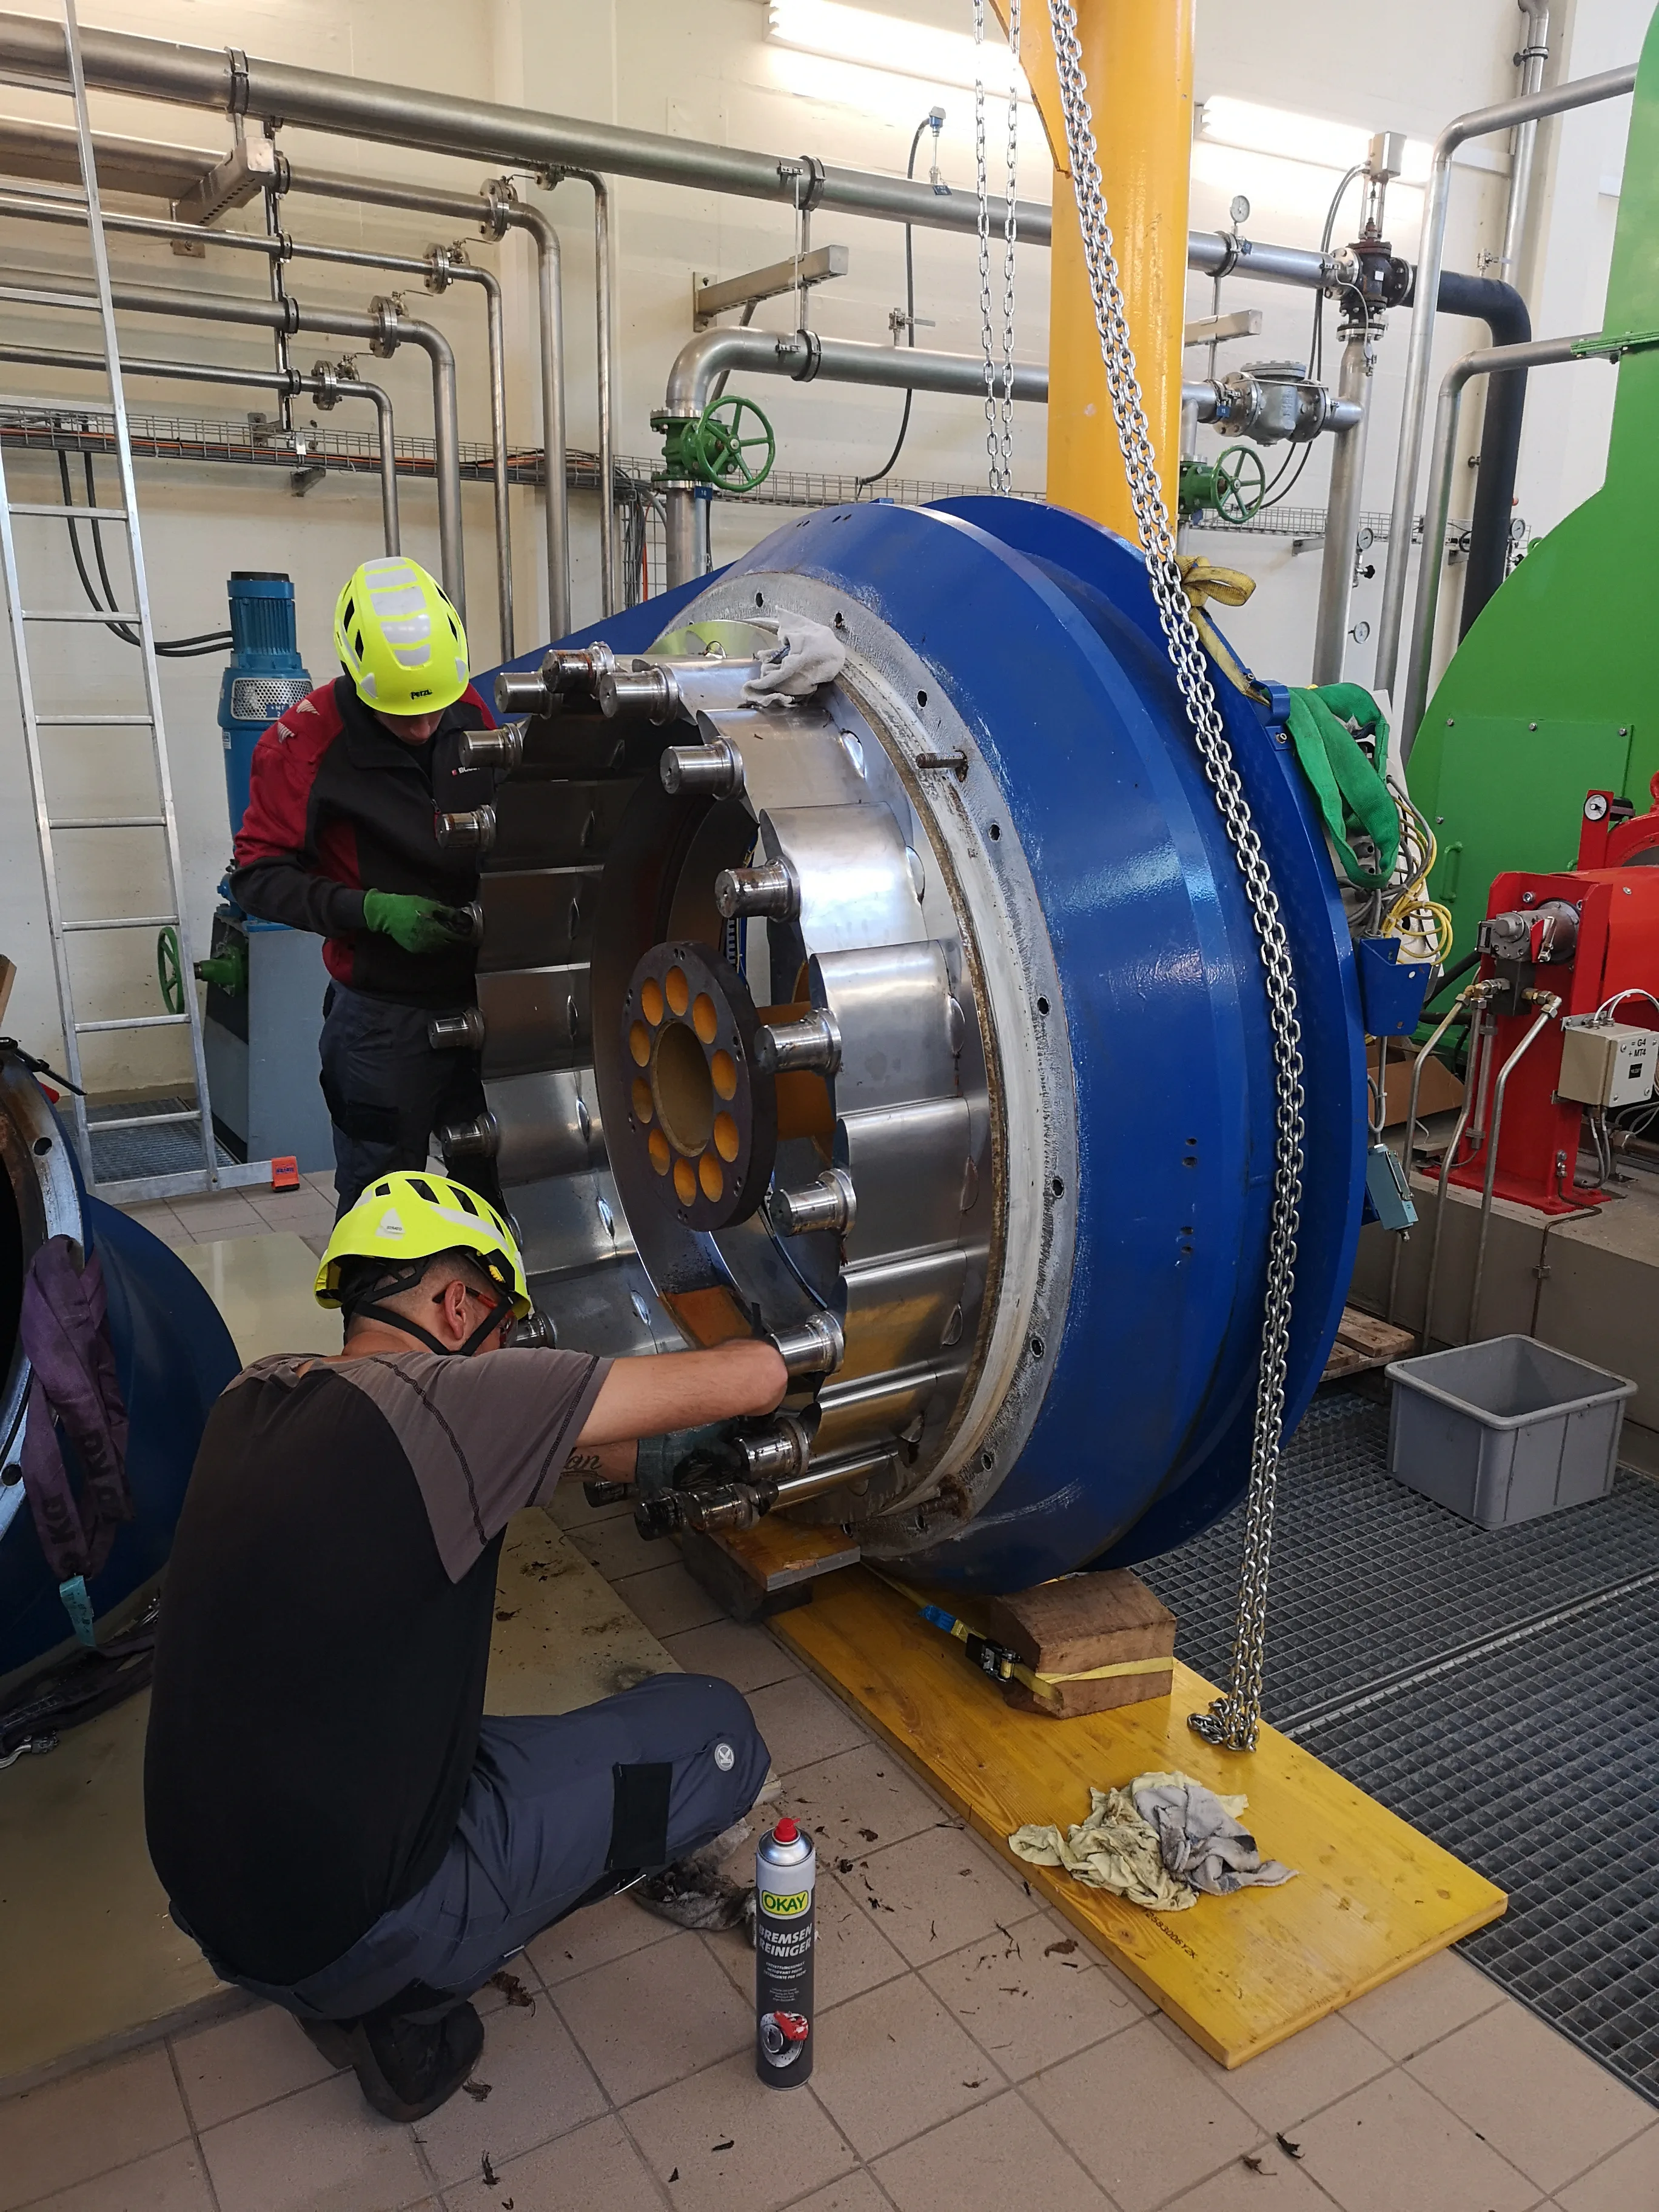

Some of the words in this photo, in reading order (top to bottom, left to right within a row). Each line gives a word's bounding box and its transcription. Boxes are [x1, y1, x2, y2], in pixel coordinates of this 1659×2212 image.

[1637, 1038, 1646, 1047] G4
[1634, 1048, 1646, 1057] MT4
[763, 1893, 806, 1912] OKAY
[759, 1922, 813, 1945] BREMSEN
[759, 1937, 812, 1957] REINIGER
